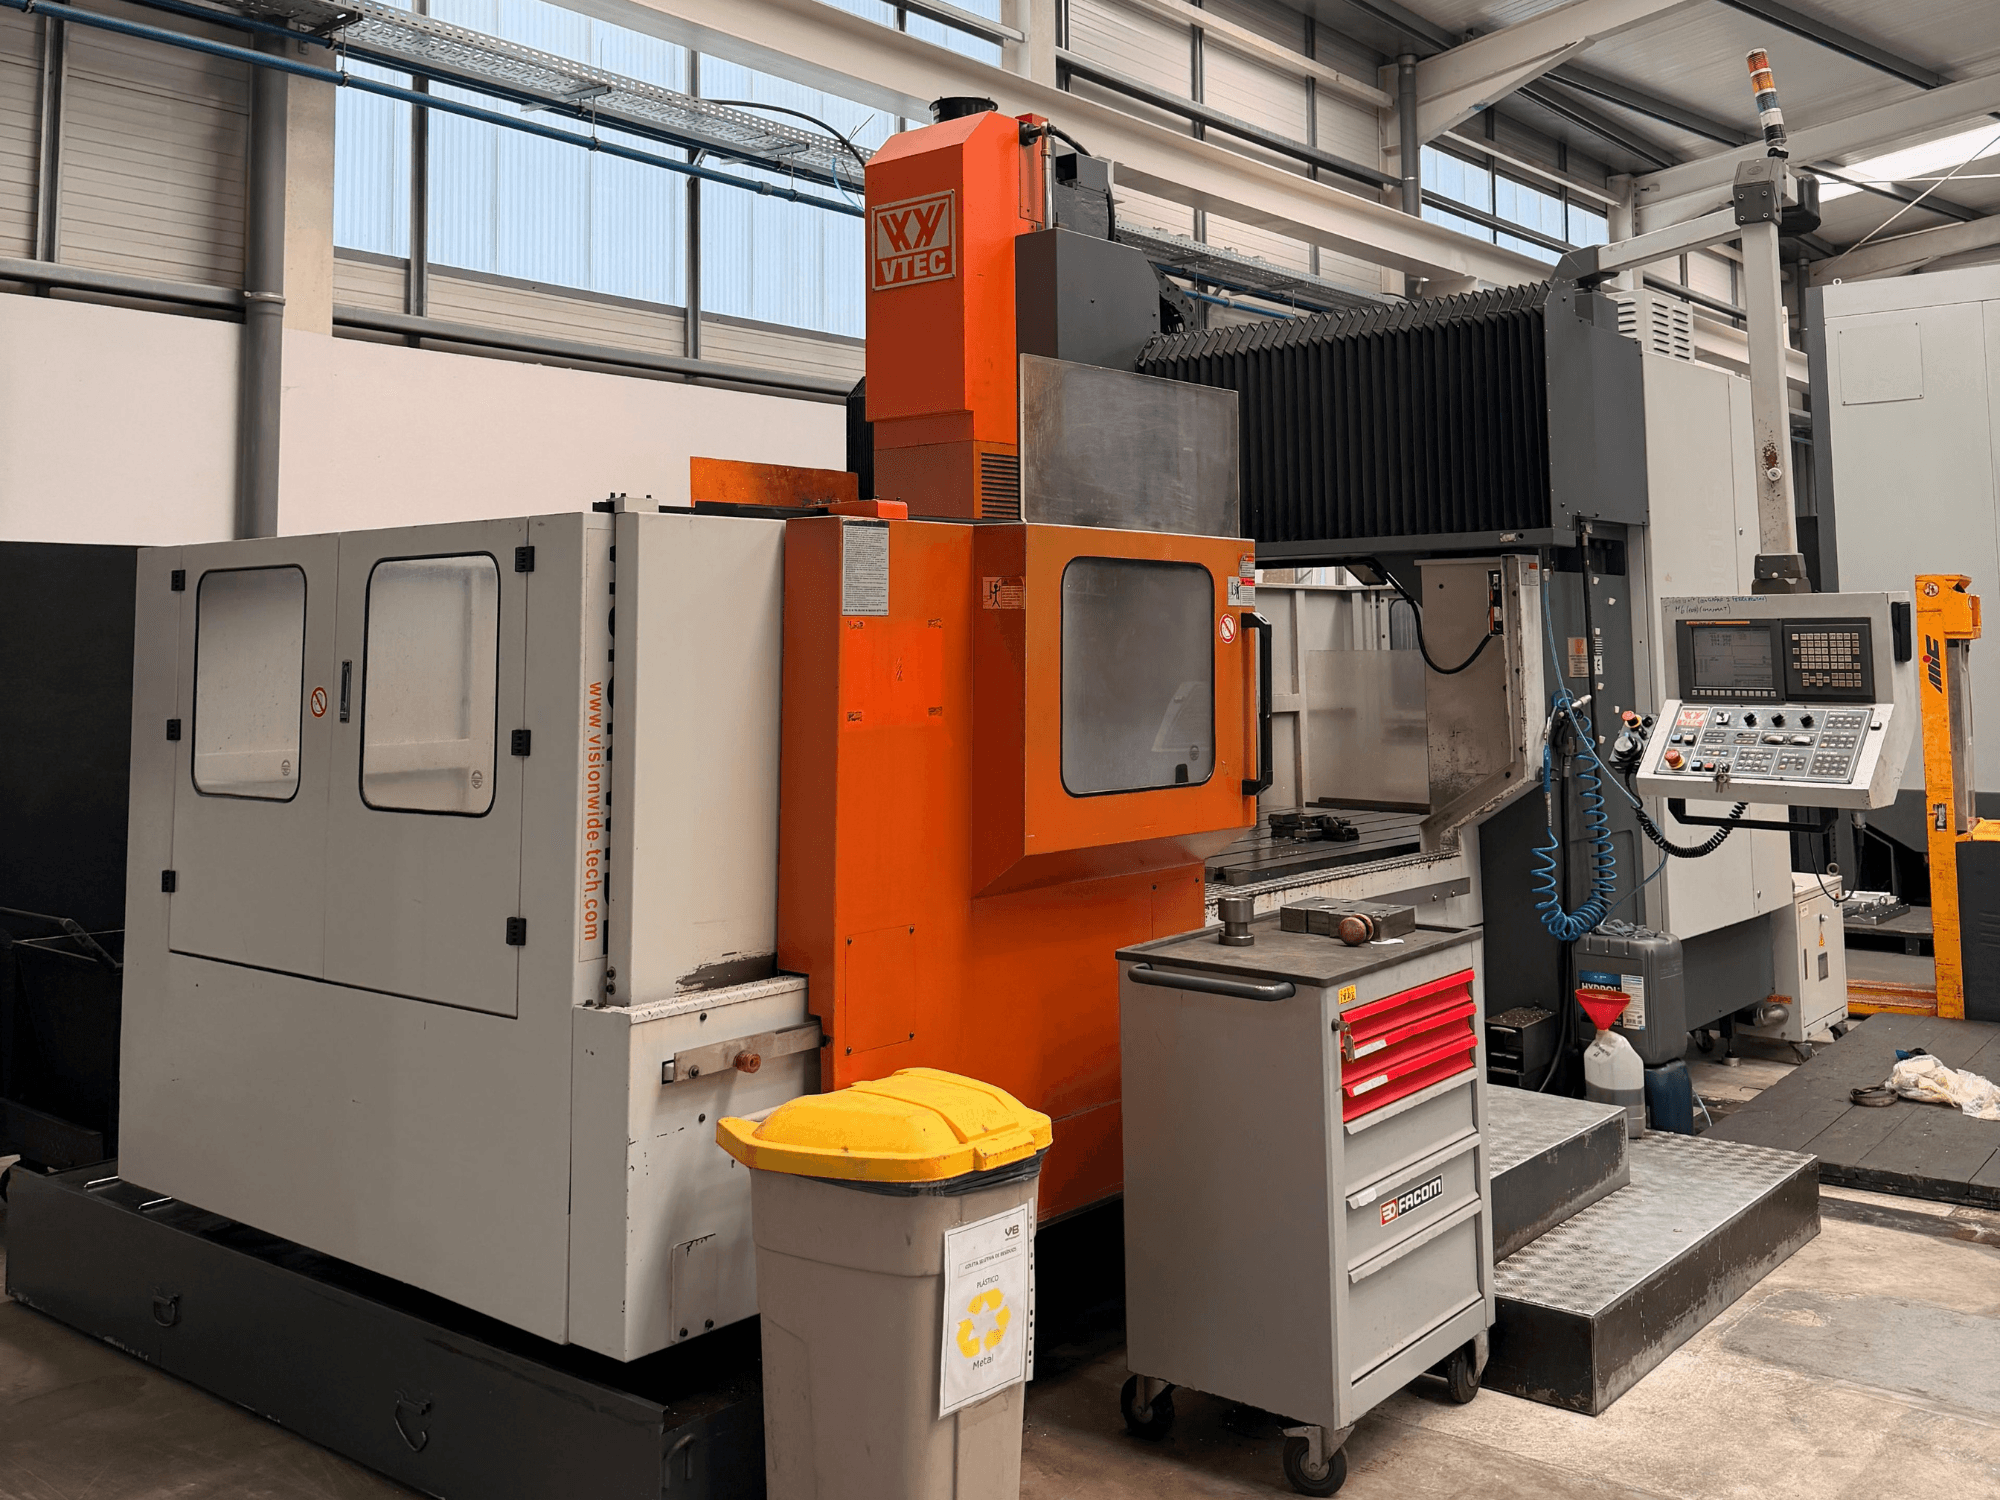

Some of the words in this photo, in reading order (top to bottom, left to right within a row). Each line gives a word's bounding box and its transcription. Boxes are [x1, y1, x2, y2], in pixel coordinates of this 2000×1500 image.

[881, 250, 946, 282] VTEC
[584, 681, 605, 941] www.visionwide-tech.com
[1398, 1178, 1442, 1214] FACOM
[1004, 1224, 1020, 1237] VB
[976, 1274, 999, 1289] PLÁSTICO
[972, 1353, 995, 1371] Metal
